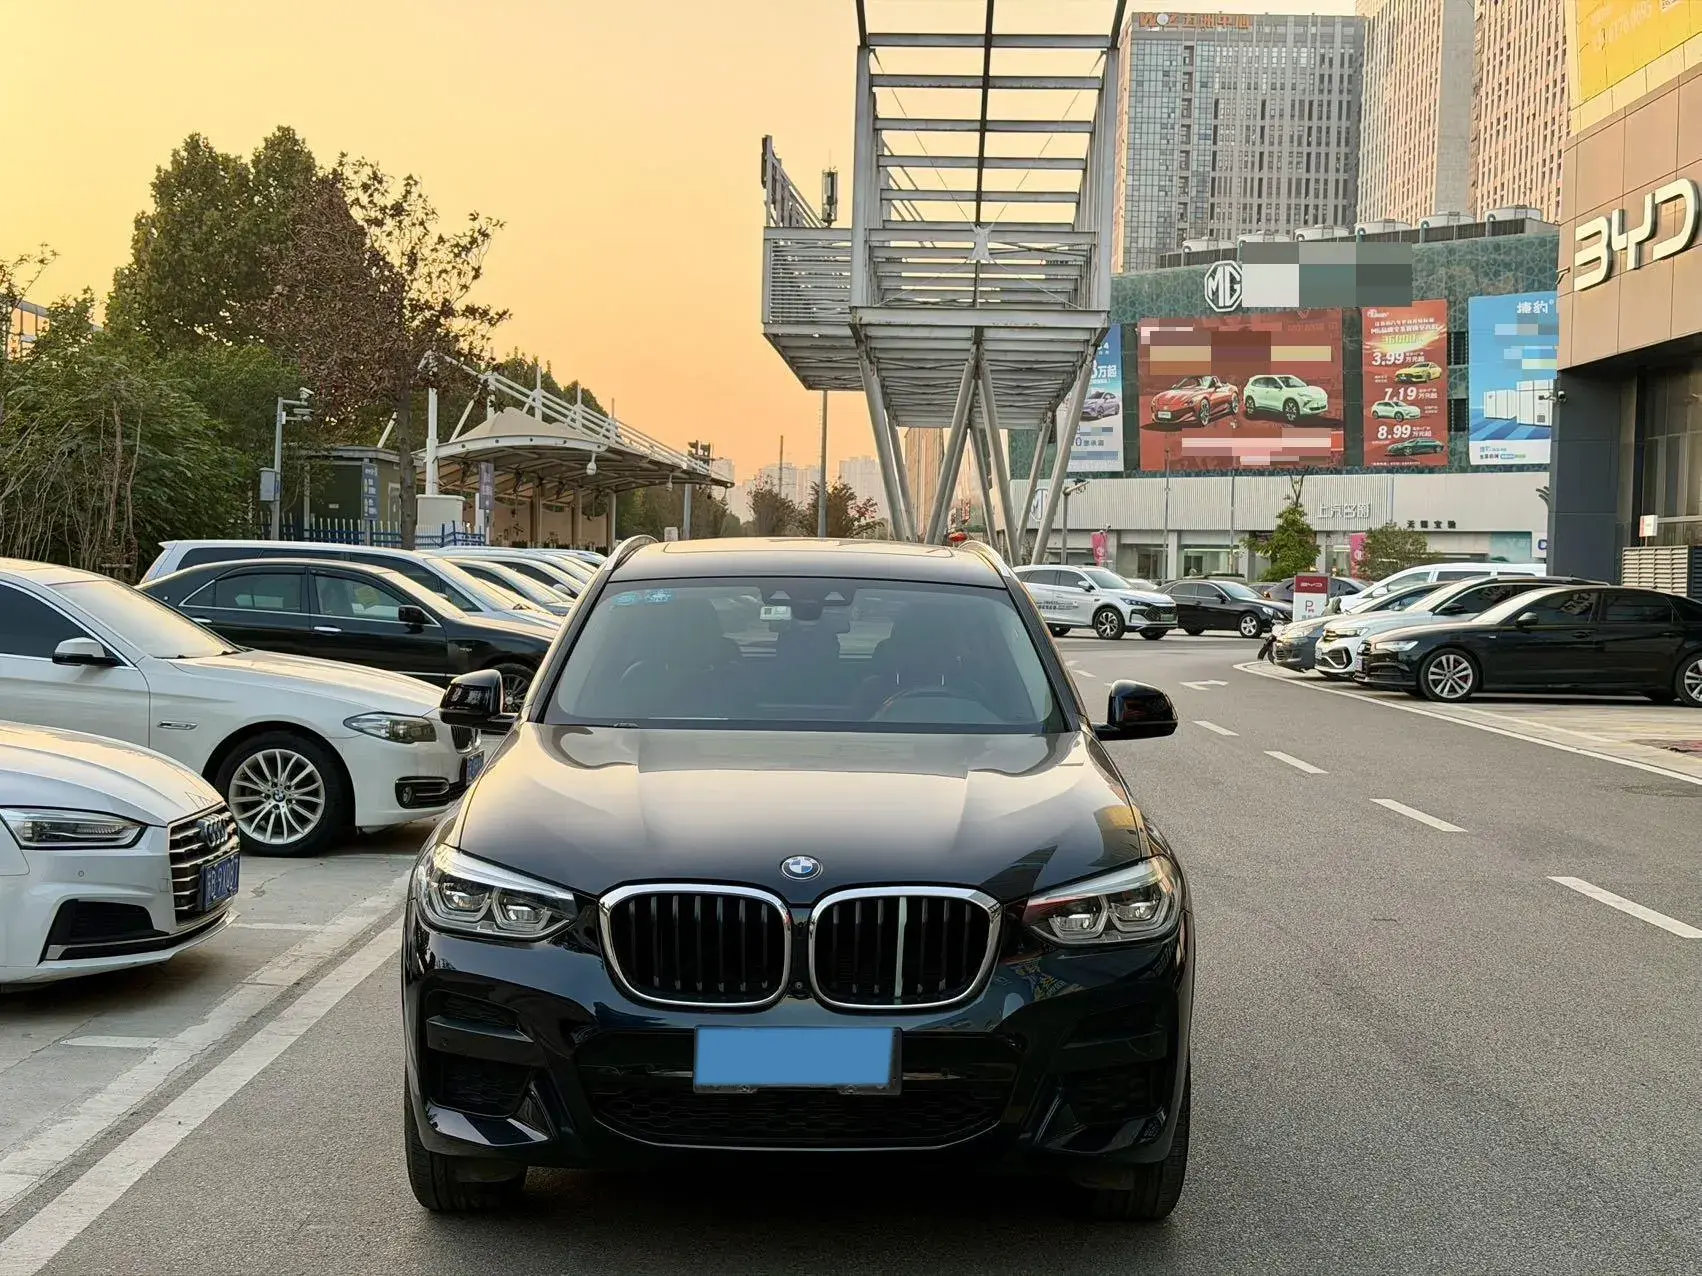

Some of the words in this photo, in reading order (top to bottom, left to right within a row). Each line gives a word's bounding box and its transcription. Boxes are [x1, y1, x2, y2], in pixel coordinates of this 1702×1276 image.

[1574, 178, 1699, 291] BYD
[1206, 264, 1241, 308] MG
[1371, 352, 1404, 366] 3.99
[1384, 386, 1417, 402] 7.19
[1377, 425, 1411, 439] 8.99
[1305, 599, 1314, 612] P
